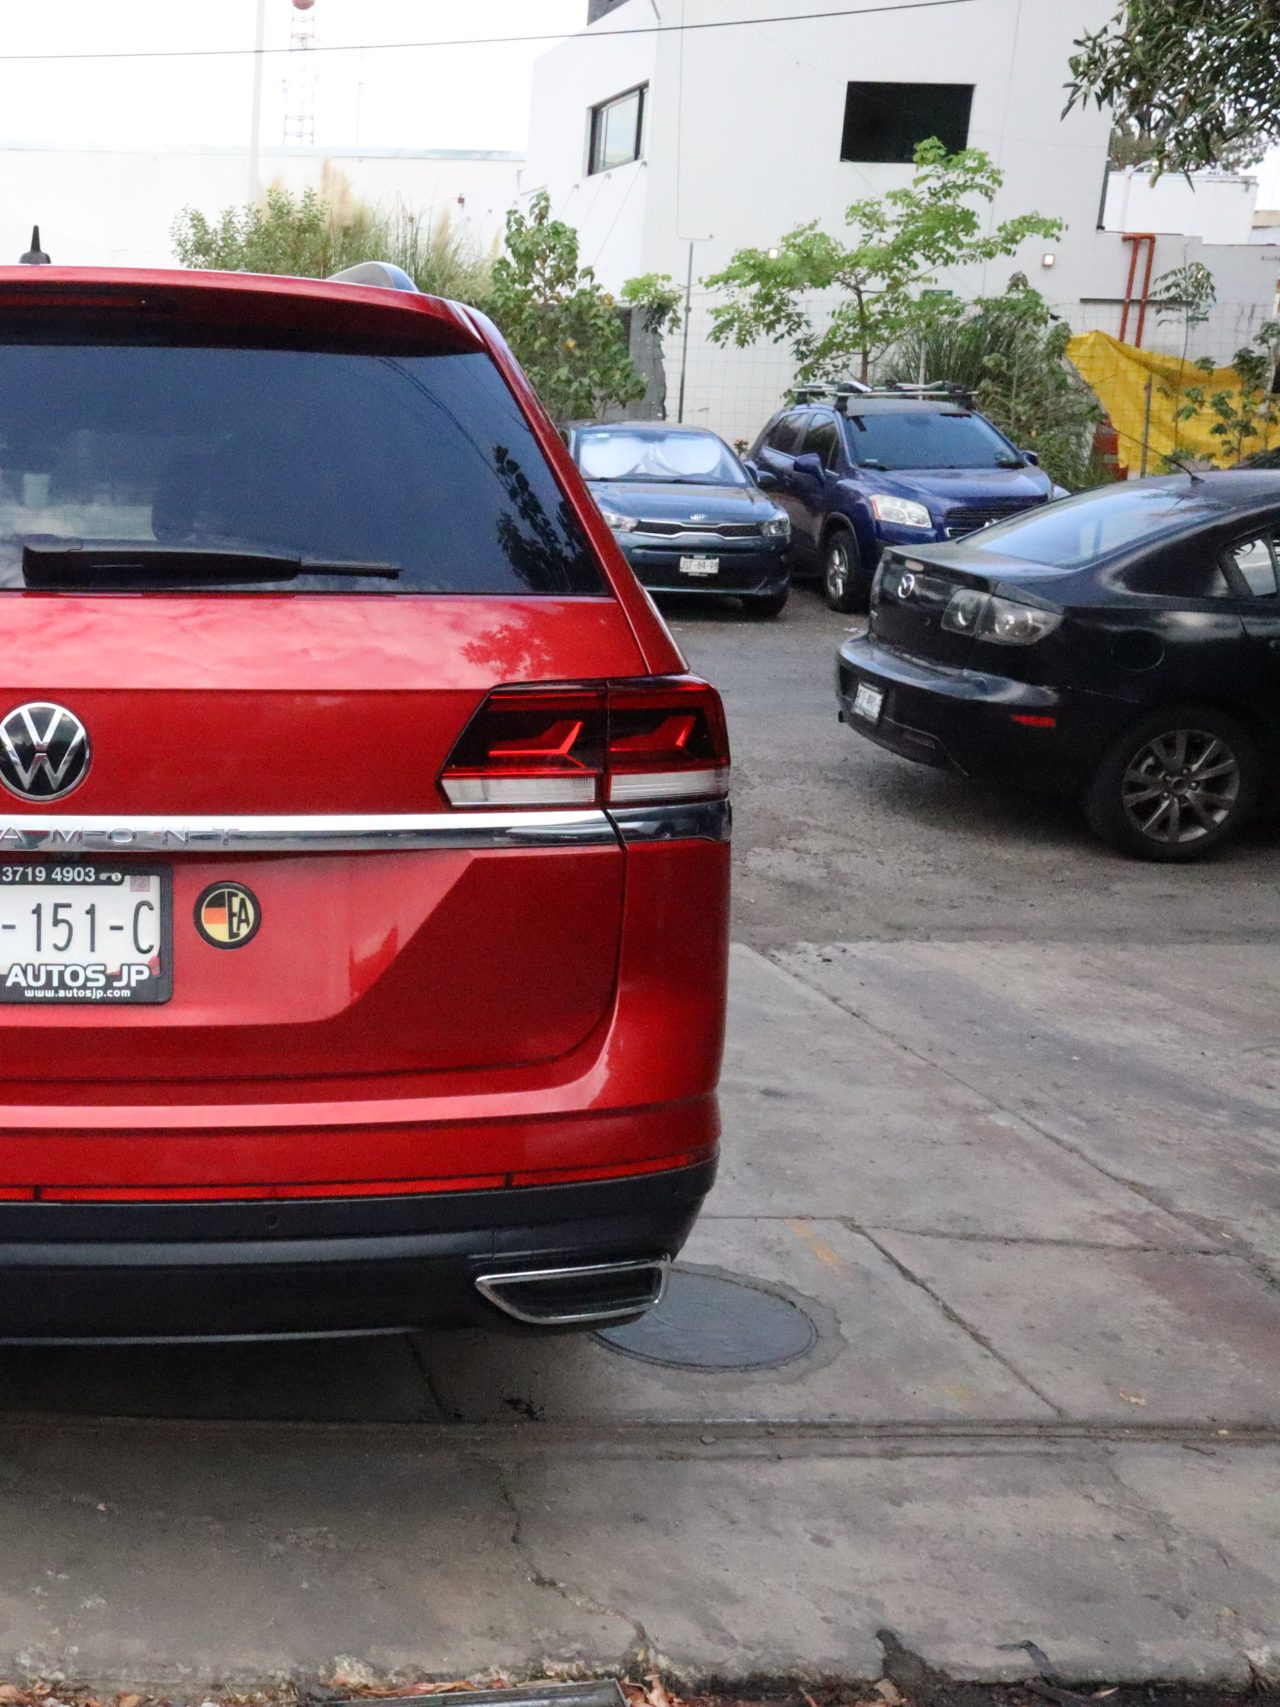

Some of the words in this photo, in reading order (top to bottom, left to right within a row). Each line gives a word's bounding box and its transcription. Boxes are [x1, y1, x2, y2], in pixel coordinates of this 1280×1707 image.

[2, 867, 47, 882] 3719
[51, 867, 96, 882] 4903
[5, 964, 106, 987] AUTOS
[113, 964, 150, 987] JP
[24, 987, 131, 999] www.autosjp.com
